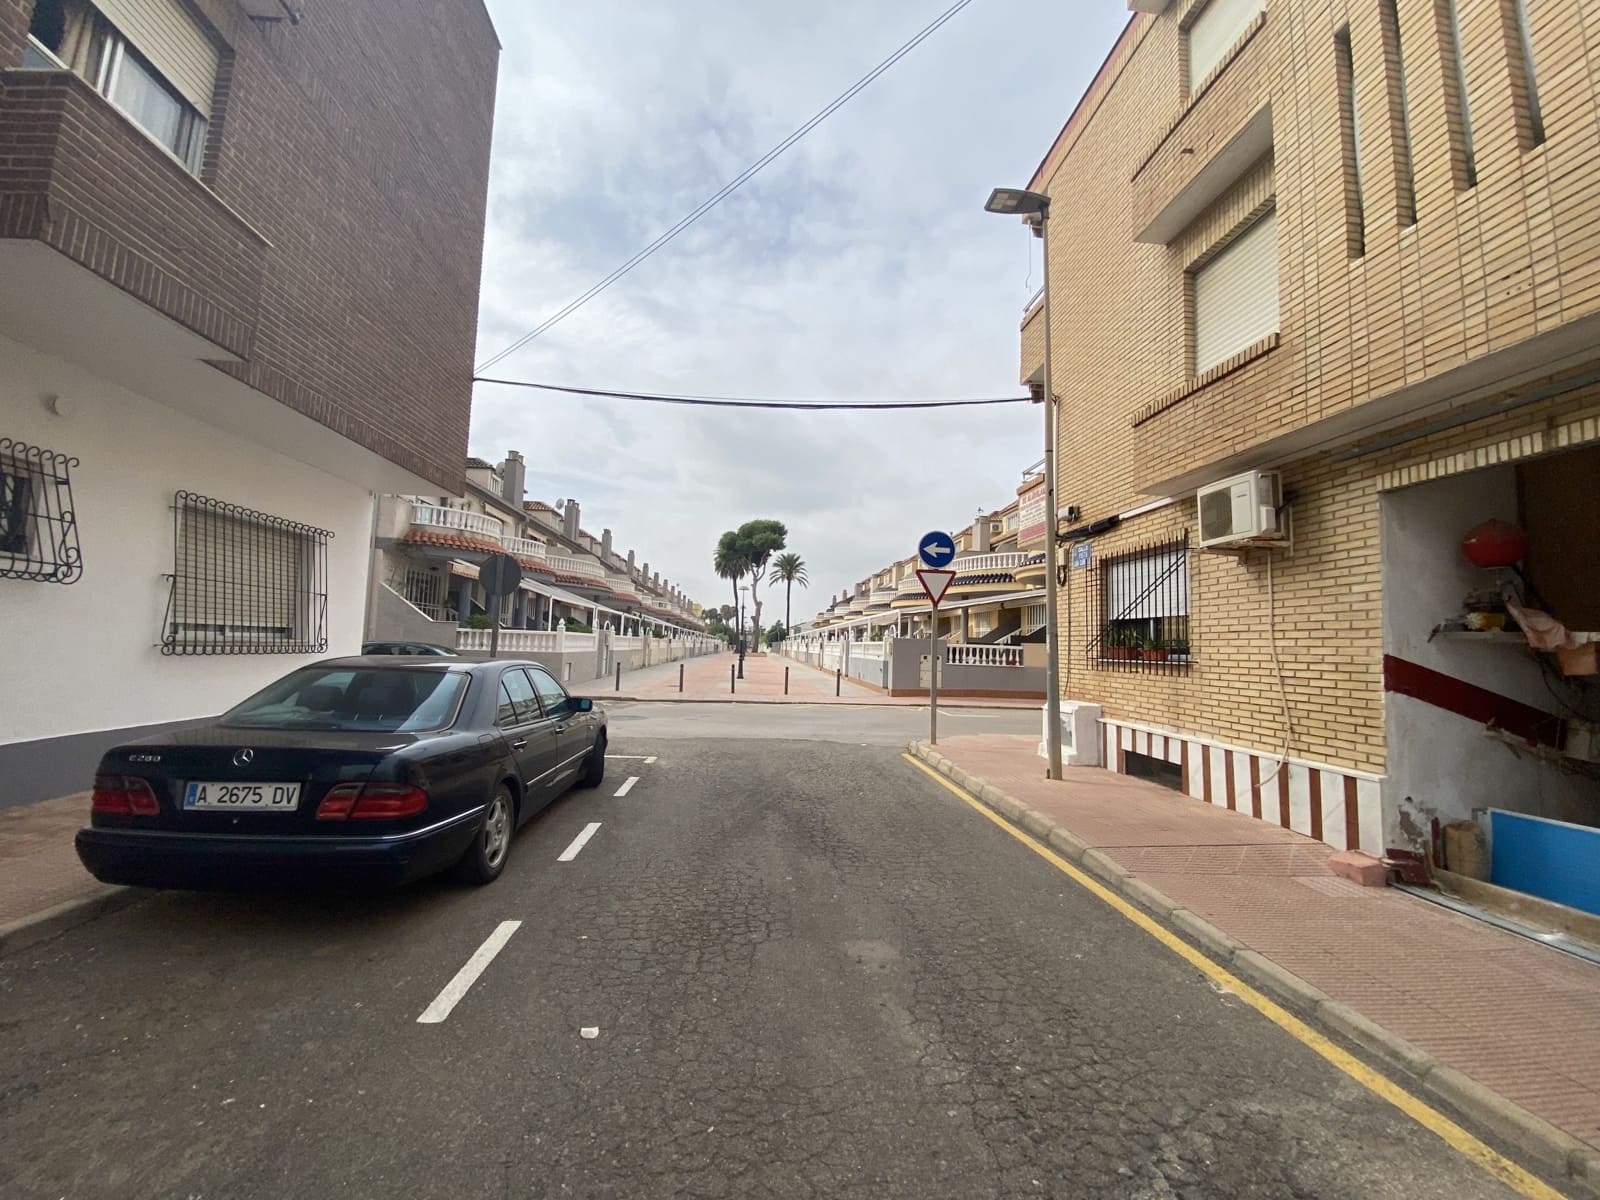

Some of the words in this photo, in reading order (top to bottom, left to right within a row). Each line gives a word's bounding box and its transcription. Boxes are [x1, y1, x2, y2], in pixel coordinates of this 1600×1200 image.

[196, 786, 208, 804] A
[217, 786, 263, 804] 2675
[272, 786, 297, 805] DV
